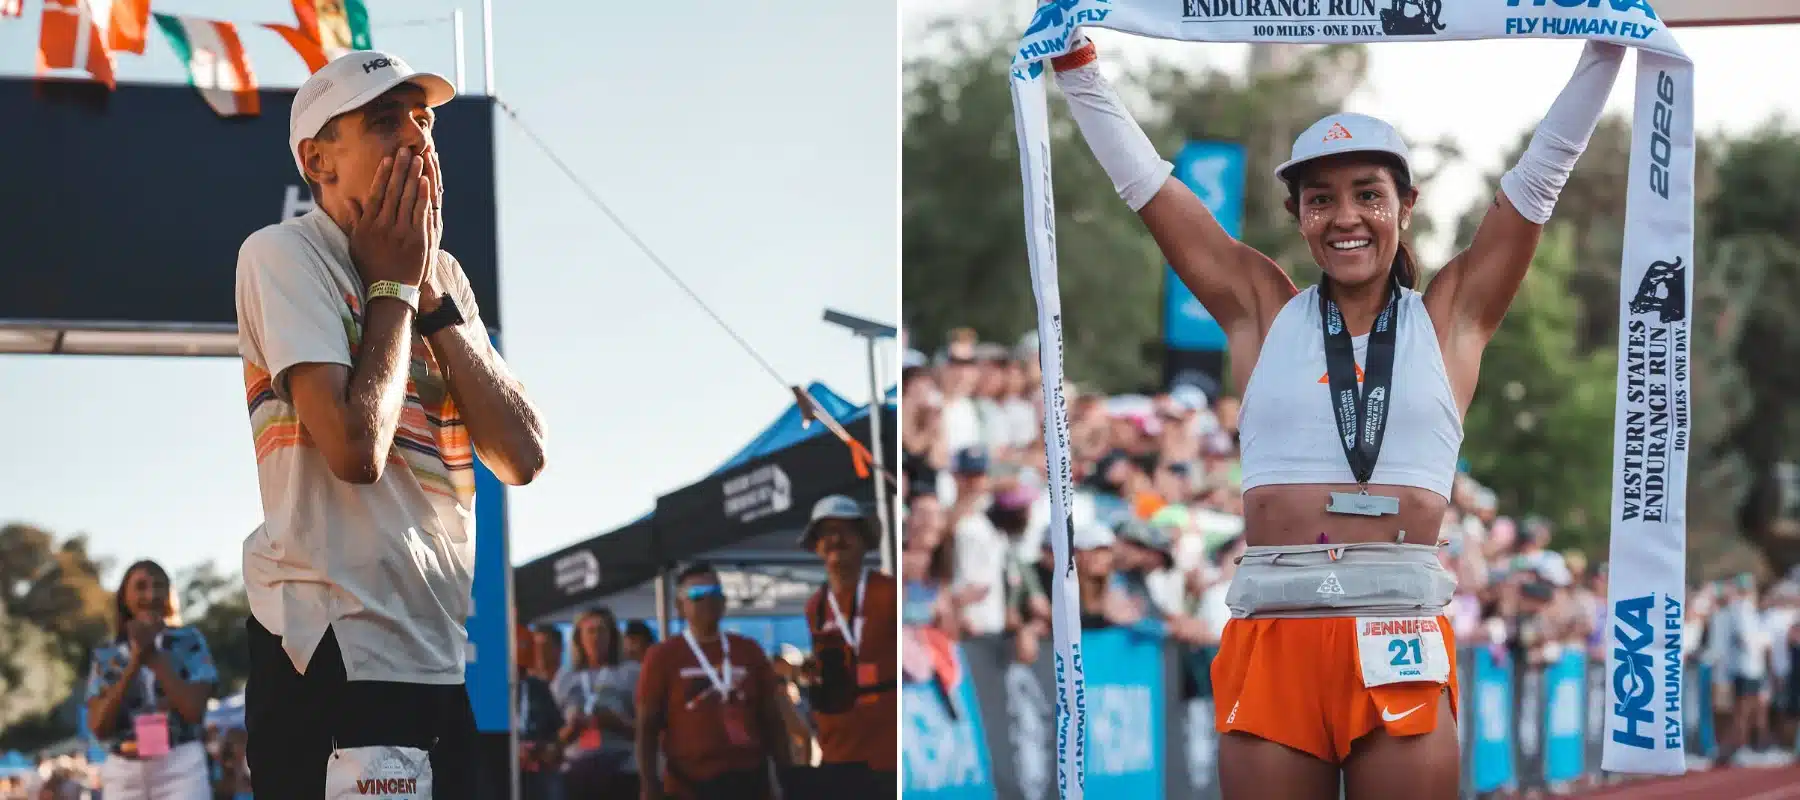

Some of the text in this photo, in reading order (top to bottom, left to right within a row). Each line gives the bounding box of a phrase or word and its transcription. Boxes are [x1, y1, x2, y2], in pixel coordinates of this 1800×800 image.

[1077, 9, 1108, 23] FLY
[1182, 0, 1376, 17] ENDURANCE RUN
[1253, 25, 1376, 36] 100 MILES ONE DAY
[1506, 18, 1654, 39] FLY HUMAN FLY
[1650, 70, 1674, 200] 2026
[1675, 328, 1687, 452] 100 MILES ONE DAY
[1622, 320, 1646, 522] WESTERN STATES
[1643, 327, 1668, 523] ENDURANCE RUN
[1363, 620, 1439, 636] JENNIFER
[1072, 644, 1083, 674] FLY
[1388, 638, 1422, 666] 21
[1056, 652, 1065, 683] FLY
[1613, 595, 1655, 750] HOKA
[1665, 594, 1681, 750] FLY HUMAN FLY
[1075, 680, 1085, 757] HUMAN
[356, 777, 417, 795] VINCENT
